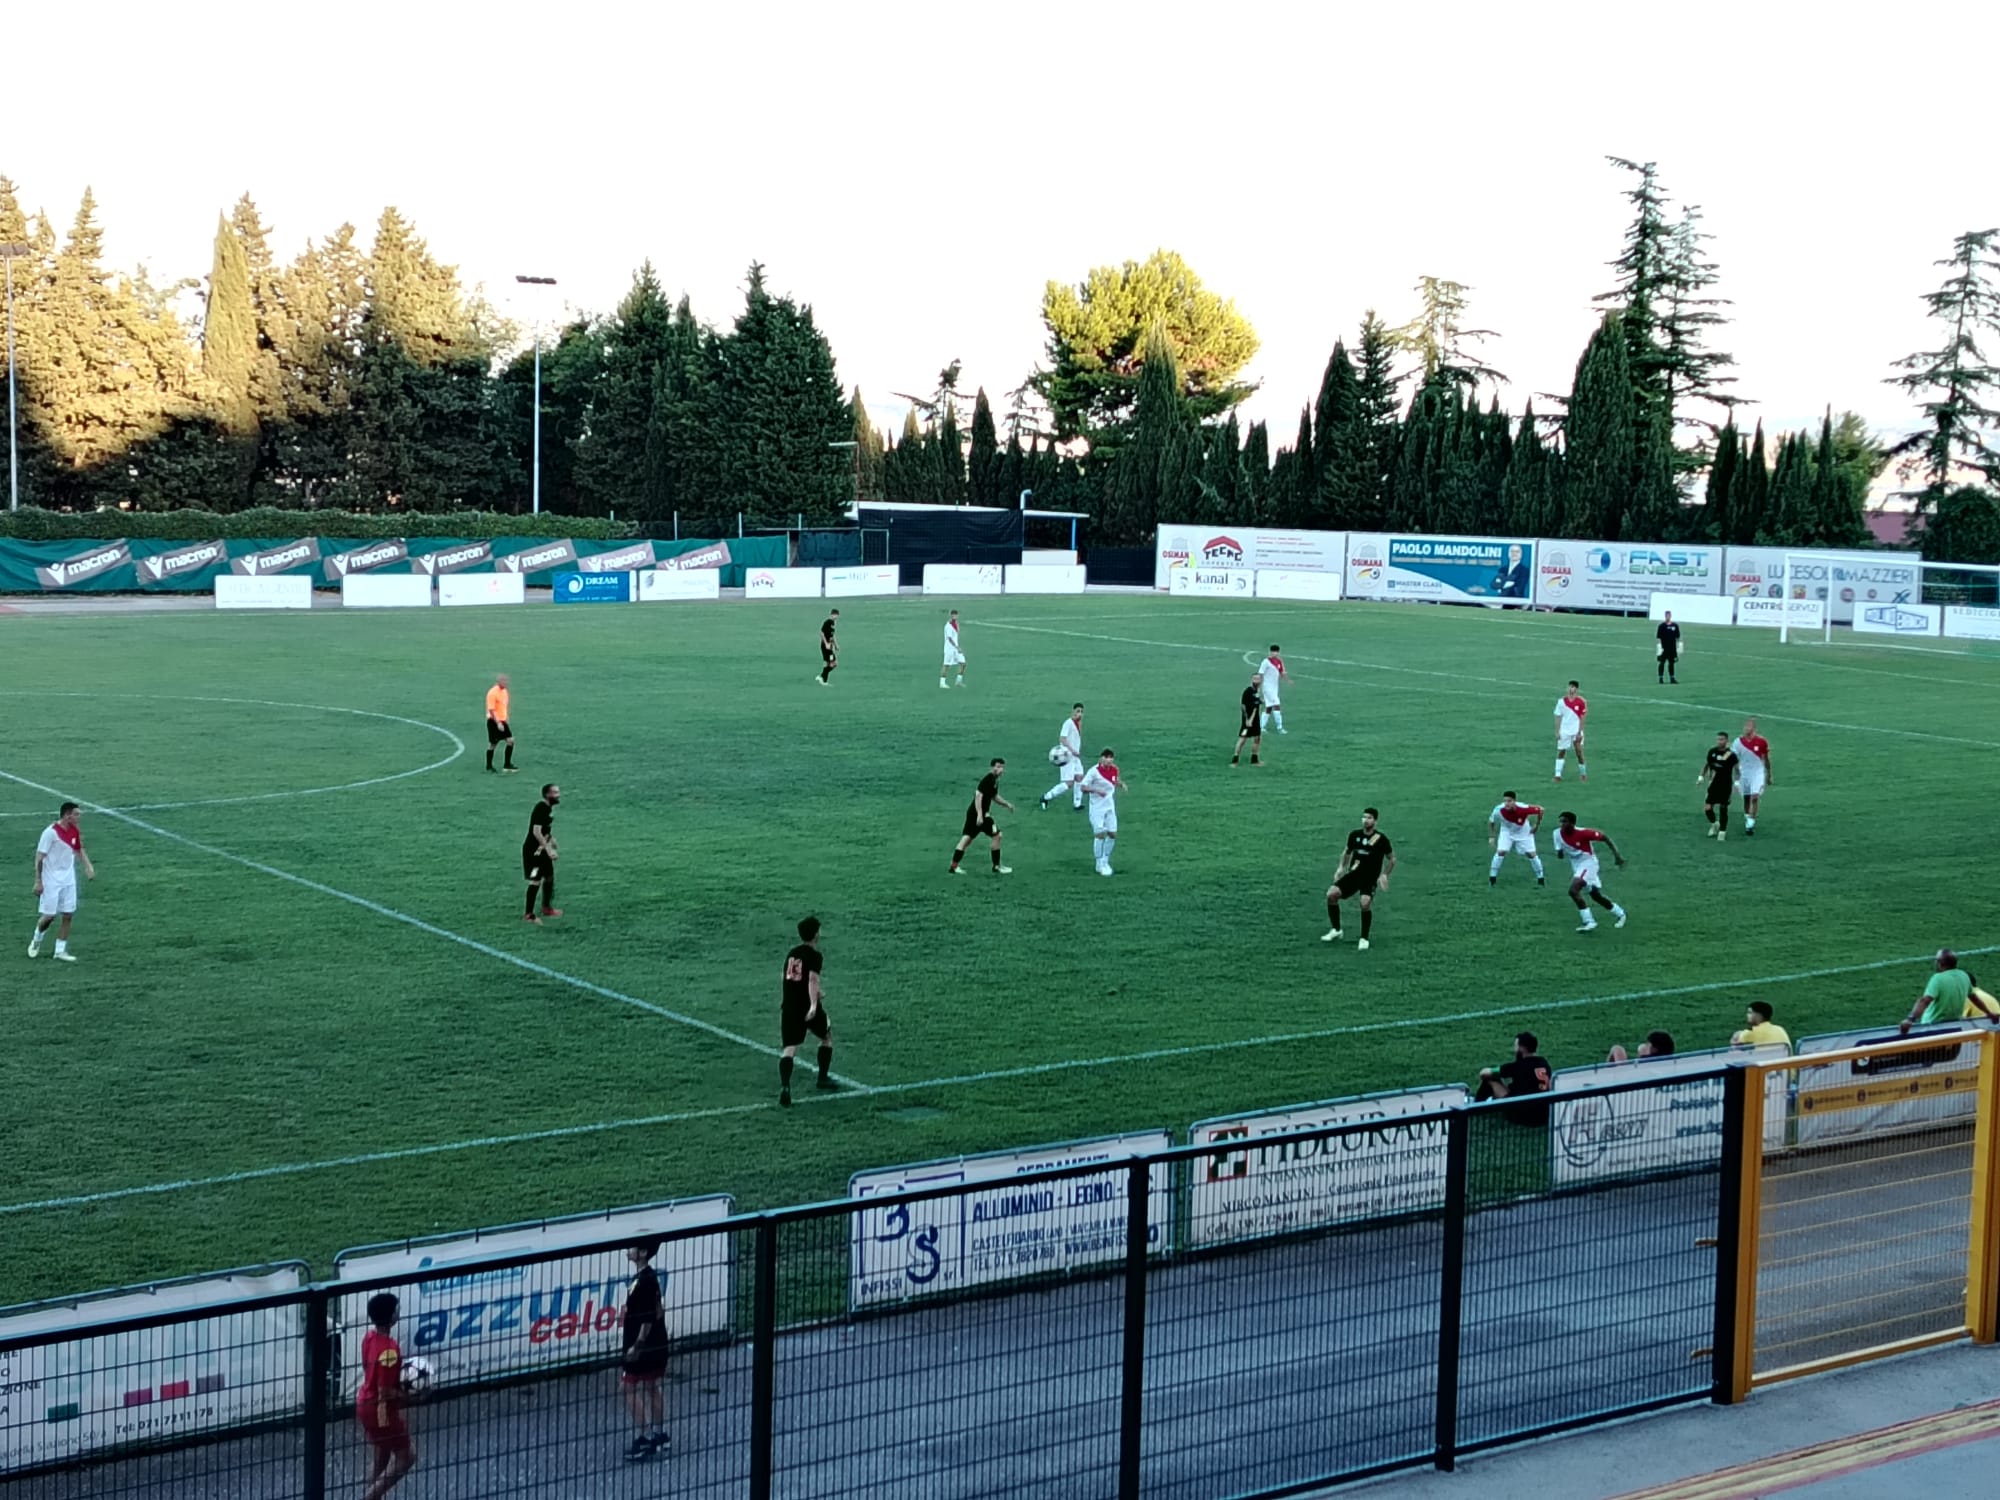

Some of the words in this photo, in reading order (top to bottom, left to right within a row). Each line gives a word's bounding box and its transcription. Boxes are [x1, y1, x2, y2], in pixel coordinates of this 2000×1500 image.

[165, 547, 217, 570] macron
[260, 545, 310, 568] macron
[350, 545, 399, 568] macron
[438, 545, 484, 568] macron
[522, 546, 568, 567] macron
[604, 549, 647, 570] macron
[680, 549, 722, 570] macron
[1162, 550, 1190, 559] OSIMAN
[1392, 543, 1432, 555] PAOLO
[1434, 544, 1502, 558] MANDOLINI
[1629, 550, 1708, 567] FAST
[67, 549, 121, 576] macron
[1629, 565, 1708, 577] ENERGY
[585, 576, 618, 585] DREAM
[1195, 571, 1228, 585] kanal
[1953, 607, 2000, 617] SEDICIG
[973, 1190, 1054, 1223] ALLUMINIO
[1067, 1180, 1113, 1208] LEGNO
[861, 1276, 902, 1296] INFISSI
[413, 1268, 670, 1347] azzurr
